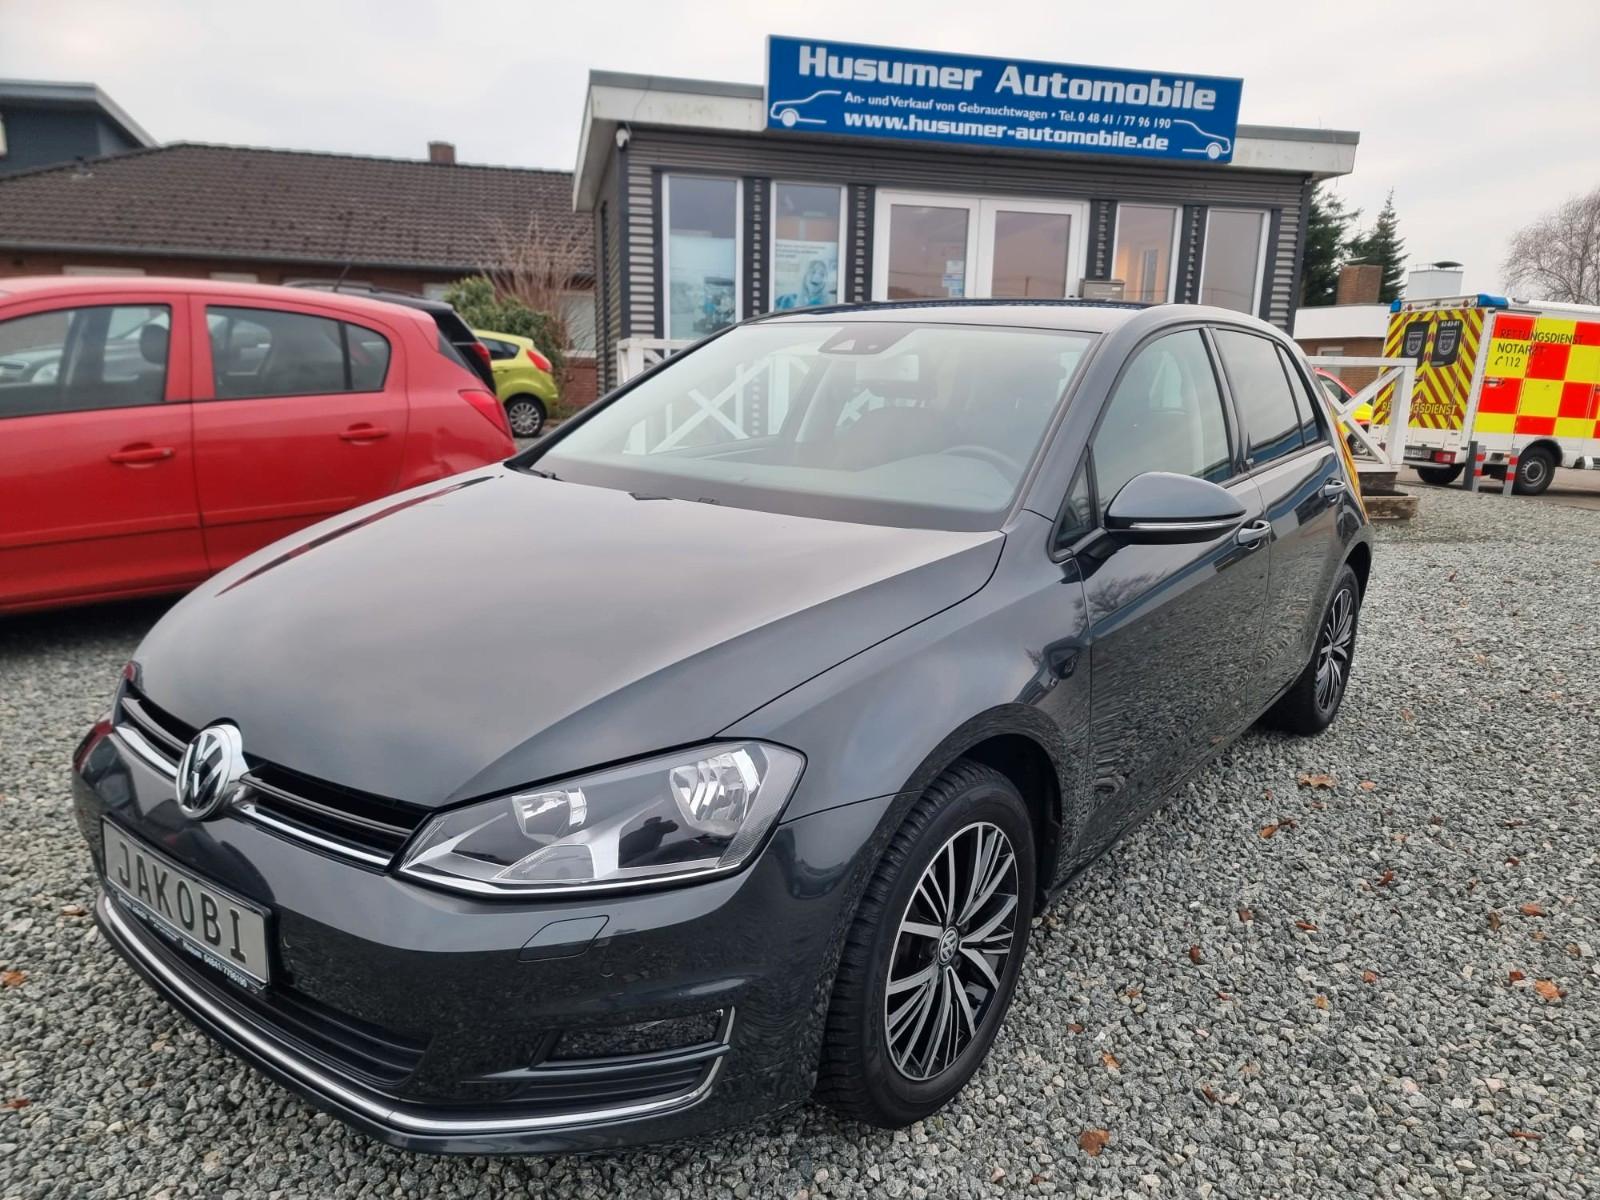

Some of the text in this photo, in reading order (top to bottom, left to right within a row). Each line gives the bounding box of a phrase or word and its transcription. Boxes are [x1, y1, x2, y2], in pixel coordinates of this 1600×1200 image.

[799, 45, 1216, 110] Husumer Automobile
[844, 92, 865, 104] An-
[868, 94, 889, 106] und
[890, 95, 934, 111] Verkauf
[935, 101, 955, 112] von
[958, 102, 1047, 121] Gebrauchtwagen
[1058, 110, 1076, 122] Tel.
[1078, 114, 1085, 122] 0
[1087, 114, 1100, 124] 48
[1102, 115, 1114, 125] 41
[1124, 115, 1135, 126] 77
[1138, 116, 1150, 127] 96
[1154, 117, 1171, 129] 190
[844, 112, 1169, 150] www.husumer-automobile.de
[1497, 342, 1545, 356] NOTARZT
[1501, 328, 1584, 345] RETTUNGSDIENST
[1505, 356, 1521, 368] 112
[117, 840, 247, 963] JAKOBI
